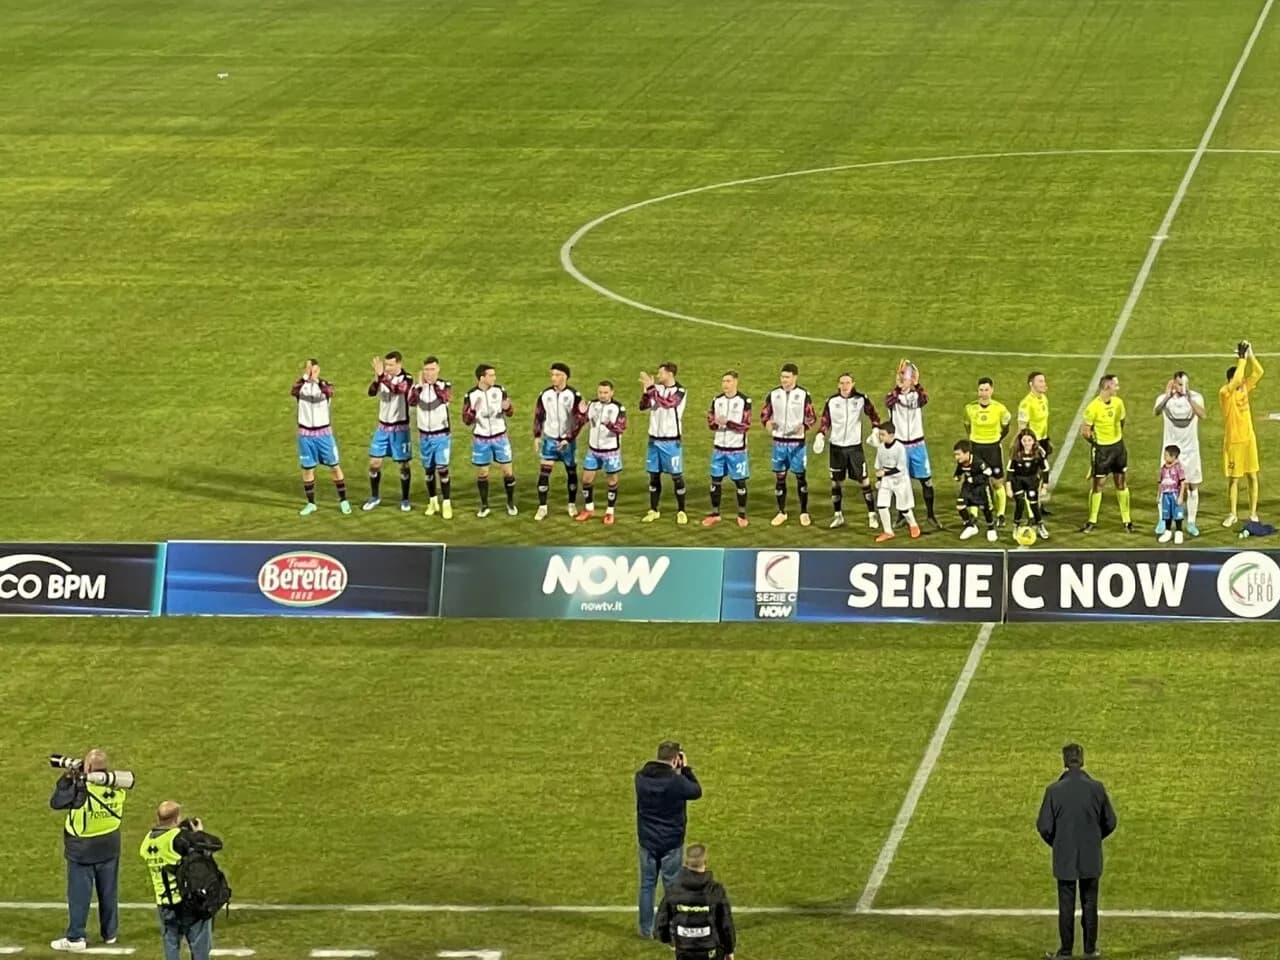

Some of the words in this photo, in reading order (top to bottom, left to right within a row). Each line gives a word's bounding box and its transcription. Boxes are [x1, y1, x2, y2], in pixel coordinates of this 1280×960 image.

[261, 564, 343, 591] Beretta
[542, 554, 670, 596] NOW
[1247, 572, 1273, 585] LEGA
[48, 574, 106, 600] BPM
[847, 562, 993, 608] SERIE
[1011, 563, 1045, 610] C
[1060, 562, 1190, 607] NOW
[1247, 584, 1273, 602] PRO
[580, 600, 623, 612] nowtv.it
[756, 593, 786, 602] SERIE
[788, 593, 797, 602] C
[758, 605, 793, 618] NOW
